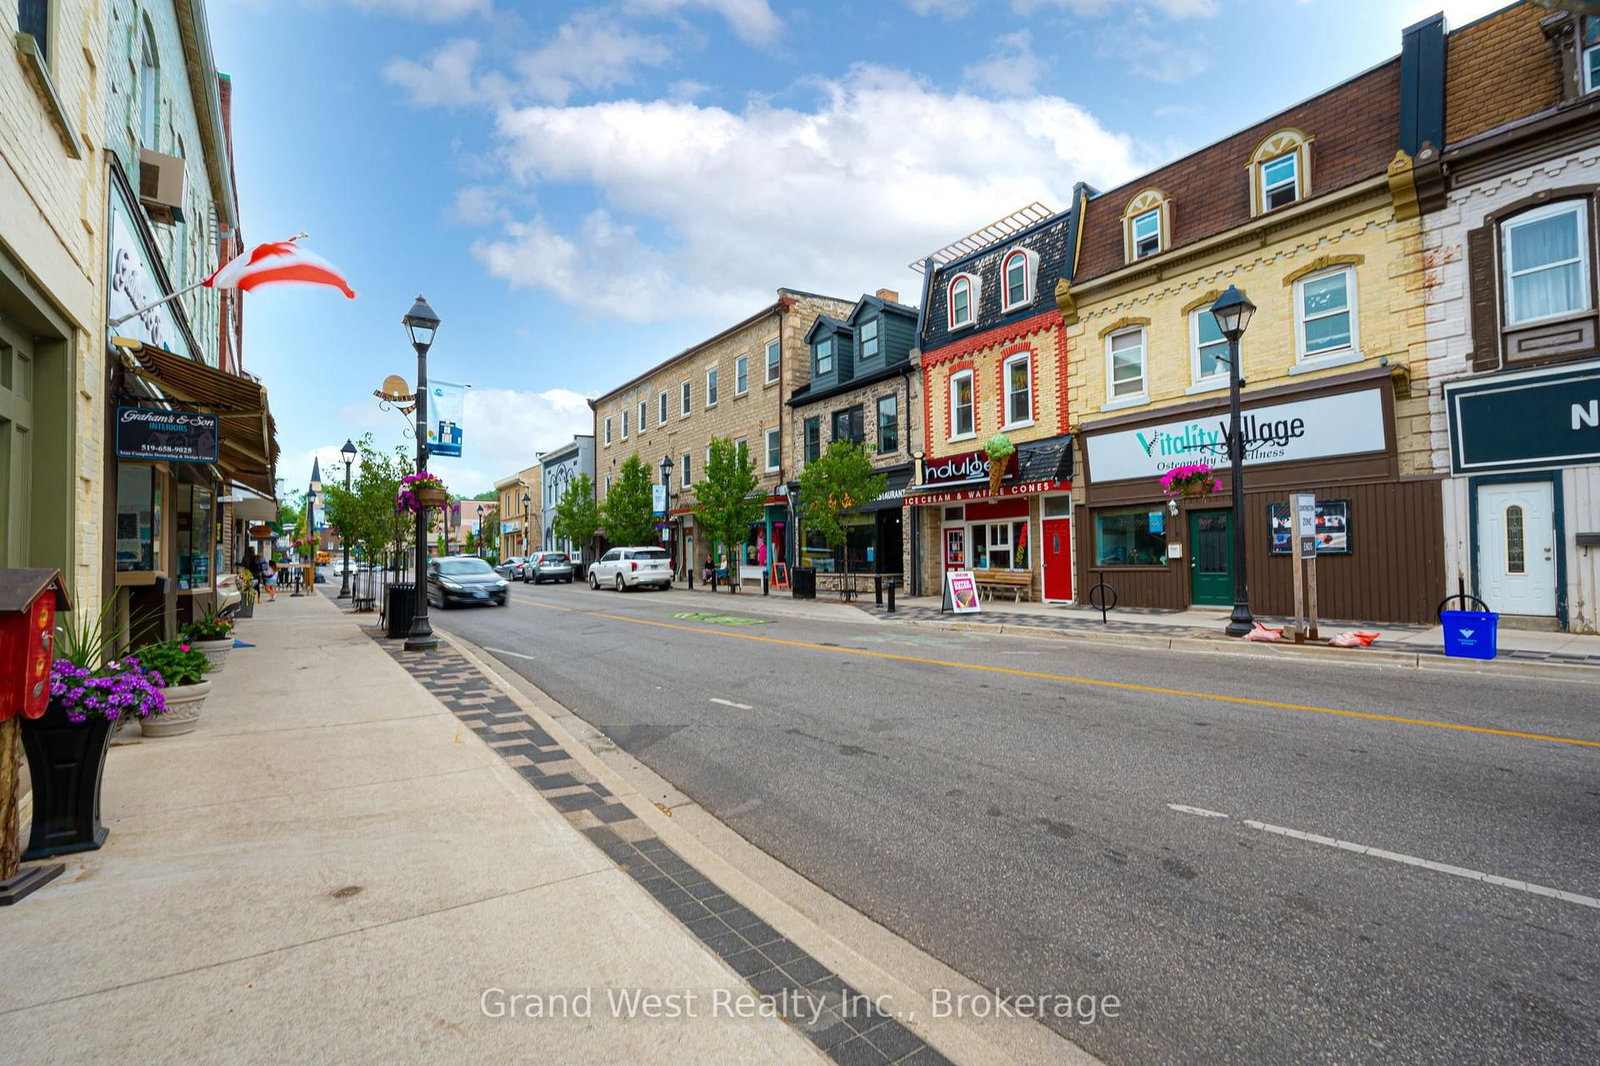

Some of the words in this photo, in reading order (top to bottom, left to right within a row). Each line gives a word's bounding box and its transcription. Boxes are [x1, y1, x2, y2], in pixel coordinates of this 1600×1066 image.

[121, 410, 174, 423] Graham's
[177, 415, 189, 424] &
[189, 416, 214, 427] Son
[149, 422, 188, 432] INTERIORS
[1135, 424, 1219, 457] Vitality
[1220, 414, 1305, 447] Vllage
[141, 444, 192, 454] 519-658-9025
[1243, 448, 1285, 461] ellness
[904, 497, 919, 506] ICE
[921, 493, 951, 504] CREAM
[957, 492, 962, 500] &
[1011, 481, 1049, 494] CONES
